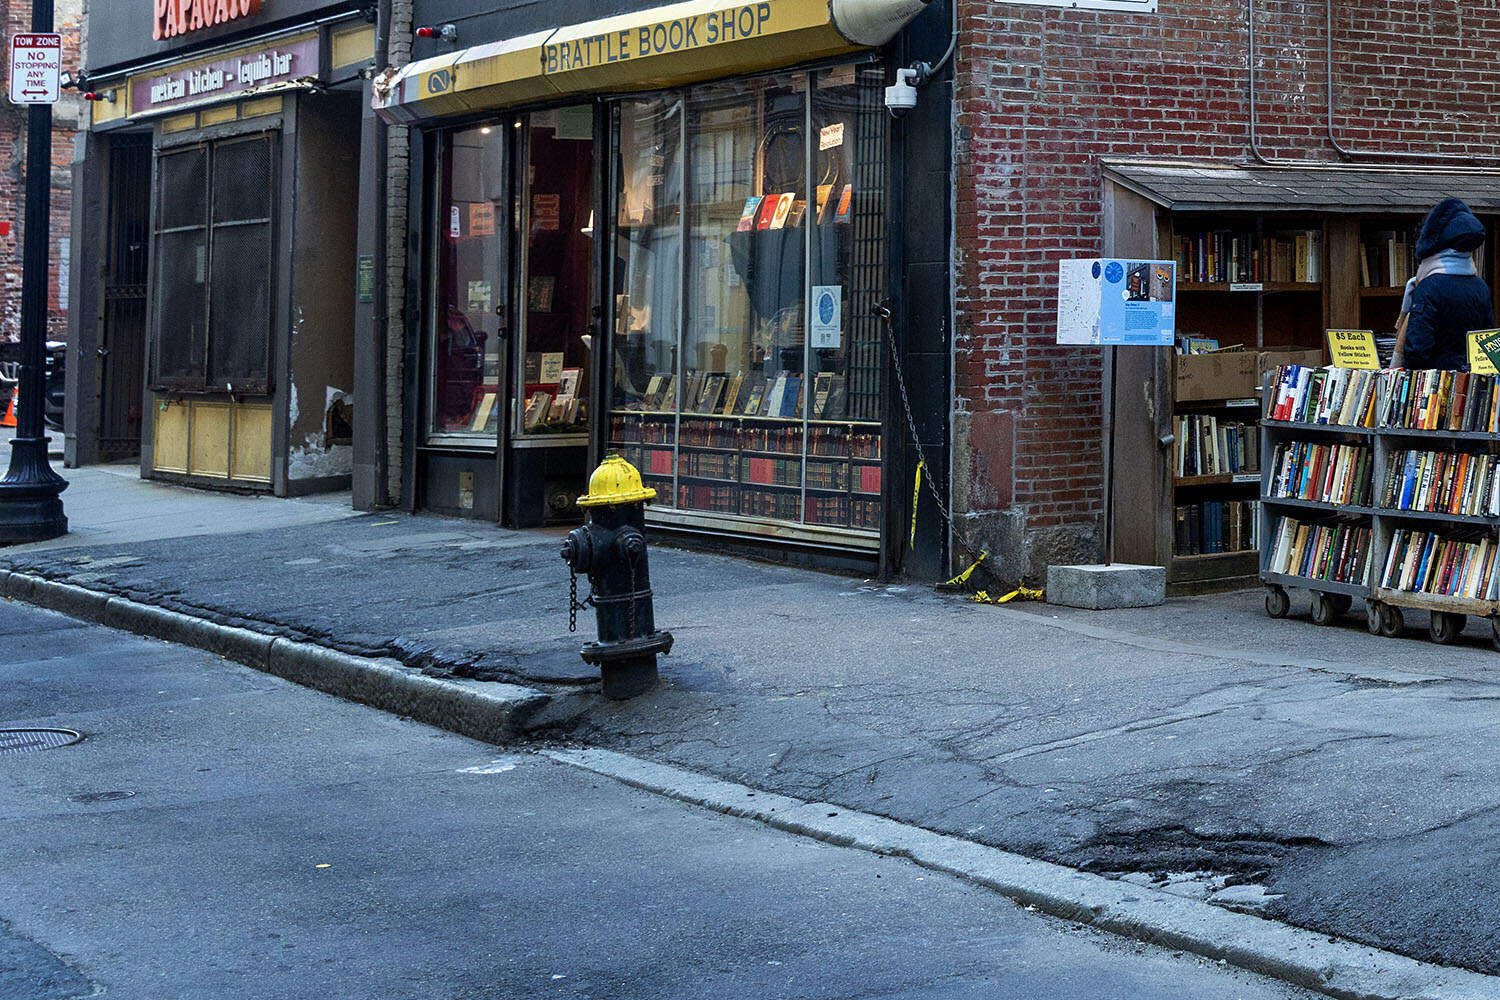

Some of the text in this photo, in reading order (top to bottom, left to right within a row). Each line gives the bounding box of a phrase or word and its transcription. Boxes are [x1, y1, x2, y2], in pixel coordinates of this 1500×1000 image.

[546, 2, 772, 73] BRATTLE BOOK SHOP
[15, 38, 59, 46] TOW ZONE
[28, 52, 46, 60] NO
[15, 62, 58, 70] STOPPING
[27, 71, 44, 79] ANY
[151, 76, 186, 103] mexican
[189, 68, 224, 96] kitchen
[238, 58, 272, 87] tequila
[274, 52, 292, 78] bar
[26, 80, 46, 88] TIME
[1336, 332, 1366, 340] $5 Each
